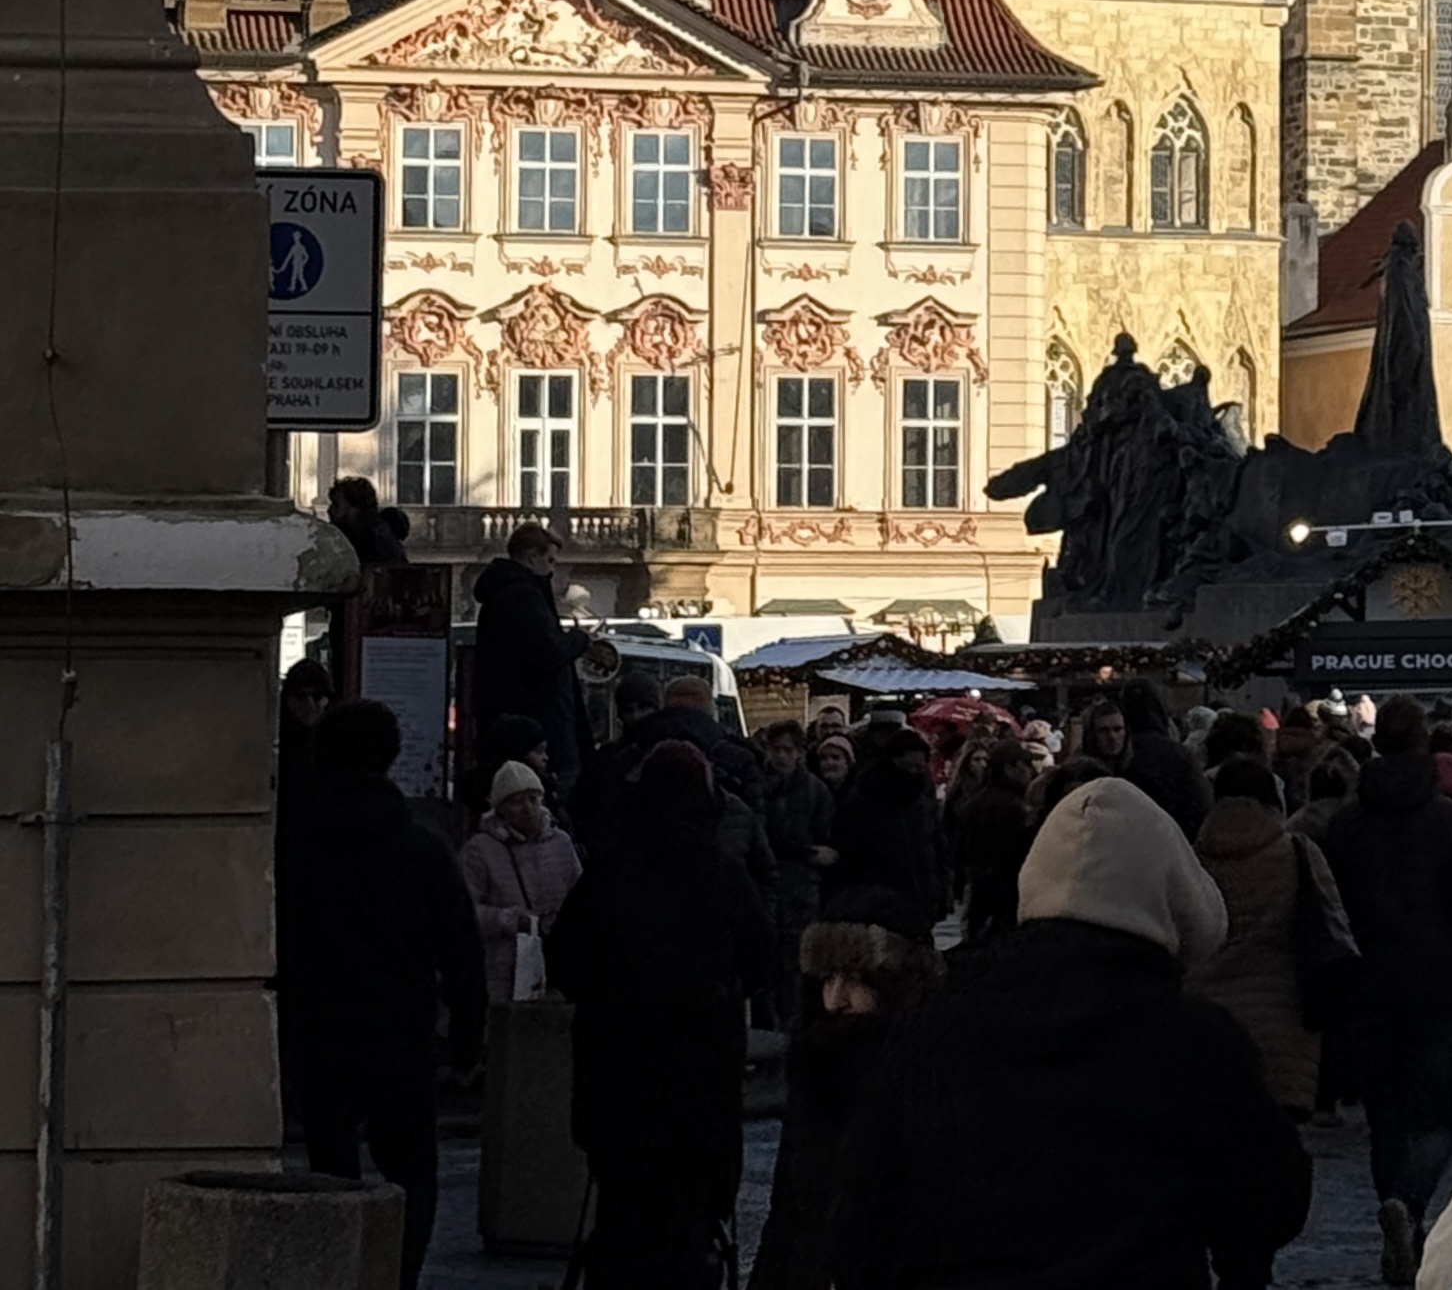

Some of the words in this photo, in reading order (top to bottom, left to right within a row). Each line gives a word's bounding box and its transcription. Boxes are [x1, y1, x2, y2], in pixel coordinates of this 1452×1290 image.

[284, 184, 357, 214] ZÓNA
[287, 325, 349, 339] OBSLUHA
[281, 376, 364, 390] SOUHLASEM
[1311, 654, 1396, 671] PRAGUE
